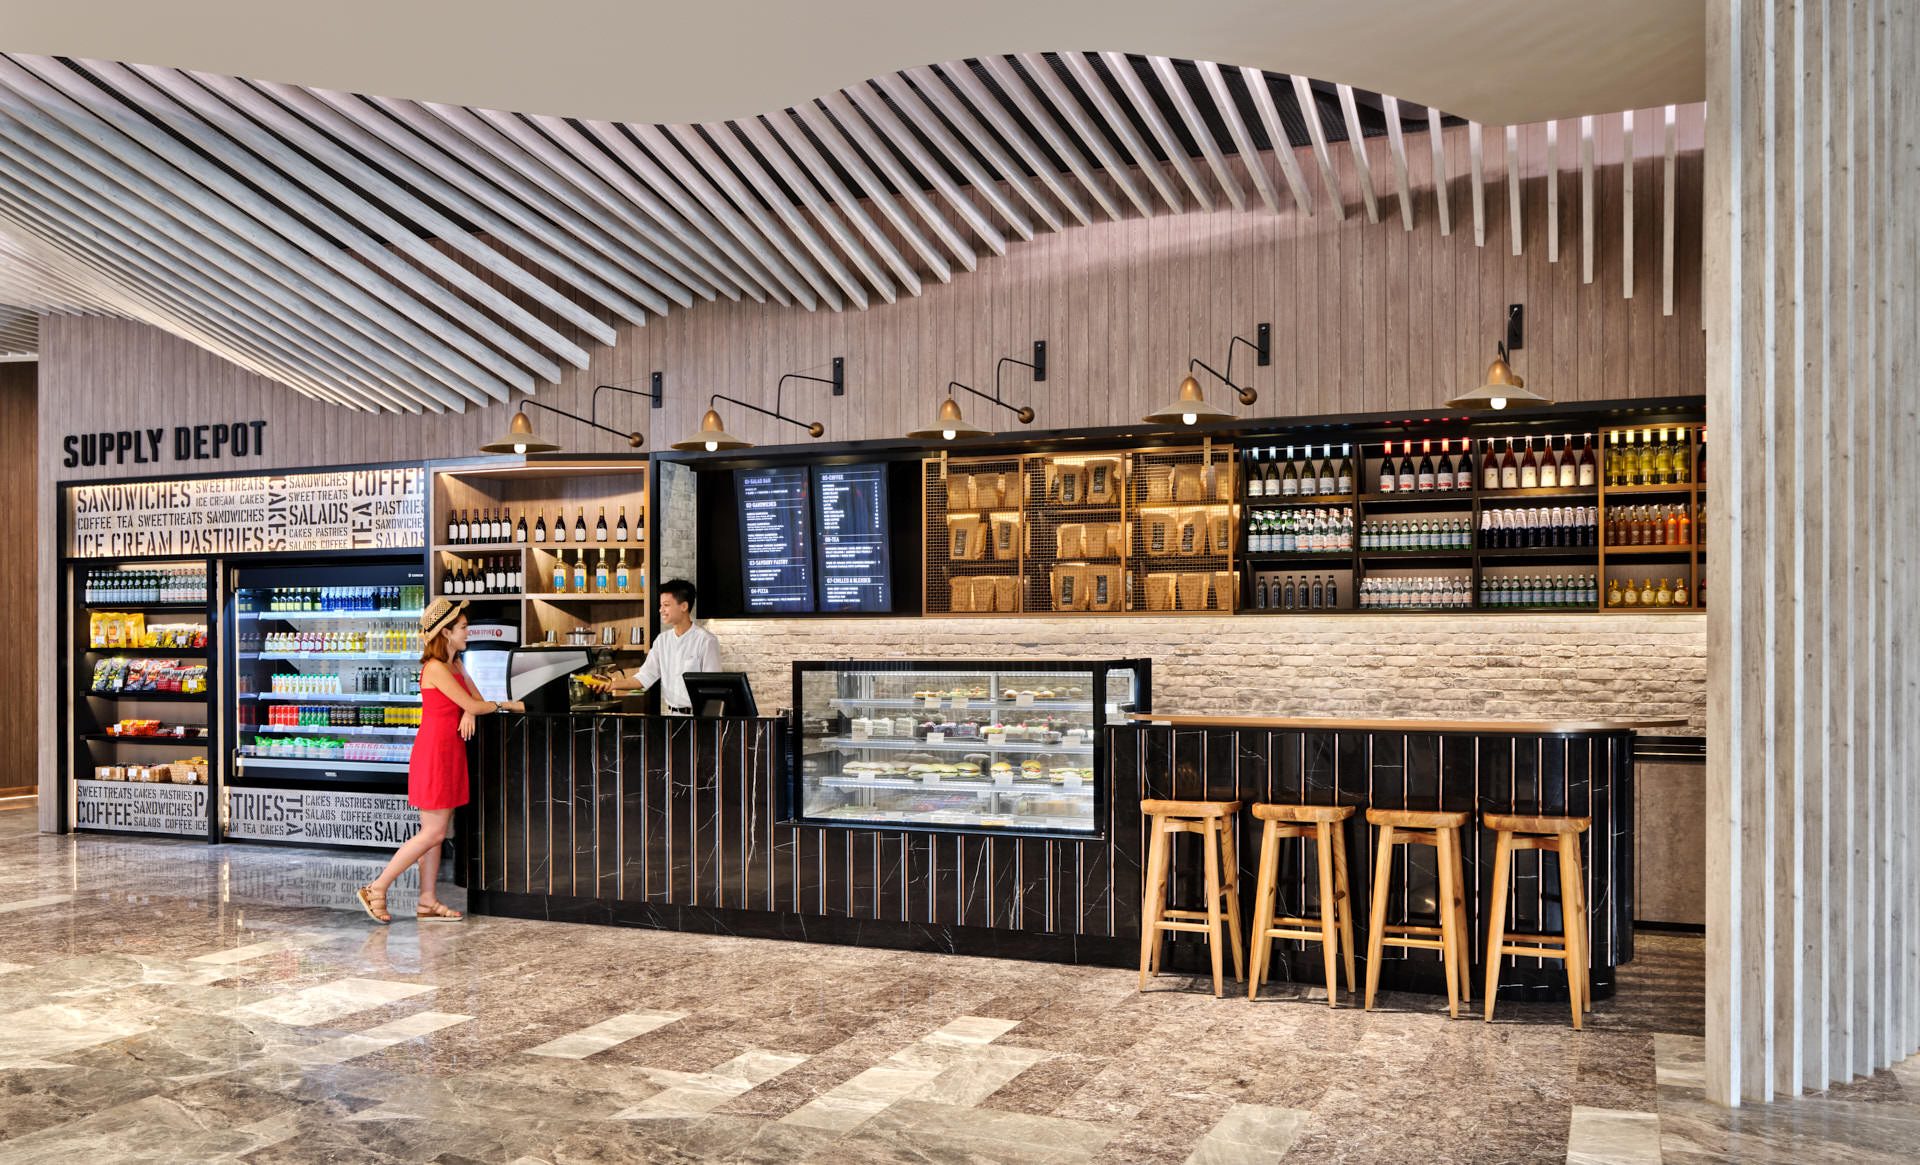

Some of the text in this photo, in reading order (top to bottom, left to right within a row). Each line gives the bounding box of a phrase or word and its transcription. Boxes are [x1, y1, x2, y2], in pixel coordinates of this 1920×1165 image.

[63, 420, 267, 468] SUPPLY DEPOT
[195, 477, 265, 494] SWEET TREATS
[289, 472, 348, 490] SANDWICHES
[77, 482, 191, 514] SANDWICHES
[195, 494, 265, 507] ICE CREAM CAKES
[288, 489, 348, 503] SWEET TREATS
[77, 508, 265, 531] COFFEE TEA SWEET TREATS SANDWICHES
[268, 475, 287, 552] CAKES
[289, 502, 349, 526] SALADS
[289, 526, 348, 539] CAKES PASTRIES
[352, 501, 373, 549] TEA
[77, 527, 264, 558] ICE CREAM PASTRIES
[289, 539, 348, 551] SALADS COFFEE
[77, 785, 193, 801] SWEET TREATS CAKES PASTRIES
[133, 800, 193, 817] SANDWICHES
[305, 795, 331, 807] CAKES
[334, 796, 372, 809] PASTRIES
[374, 798, 400, 811] SWEET
[77, 800, 133, 826] COFFEE
[285, 794, 303, 836] TEA
[305, 808, 336, 821] SALADS
[341, 810, 372, 823] COFFEE
[133, 817, 207, 831] SALADS COFFEE ICE
[243, 822, 256, 833] TEA
[260, 824, 284, 836] CAKES
[305, 822, 372, 840] SANDWICHES
